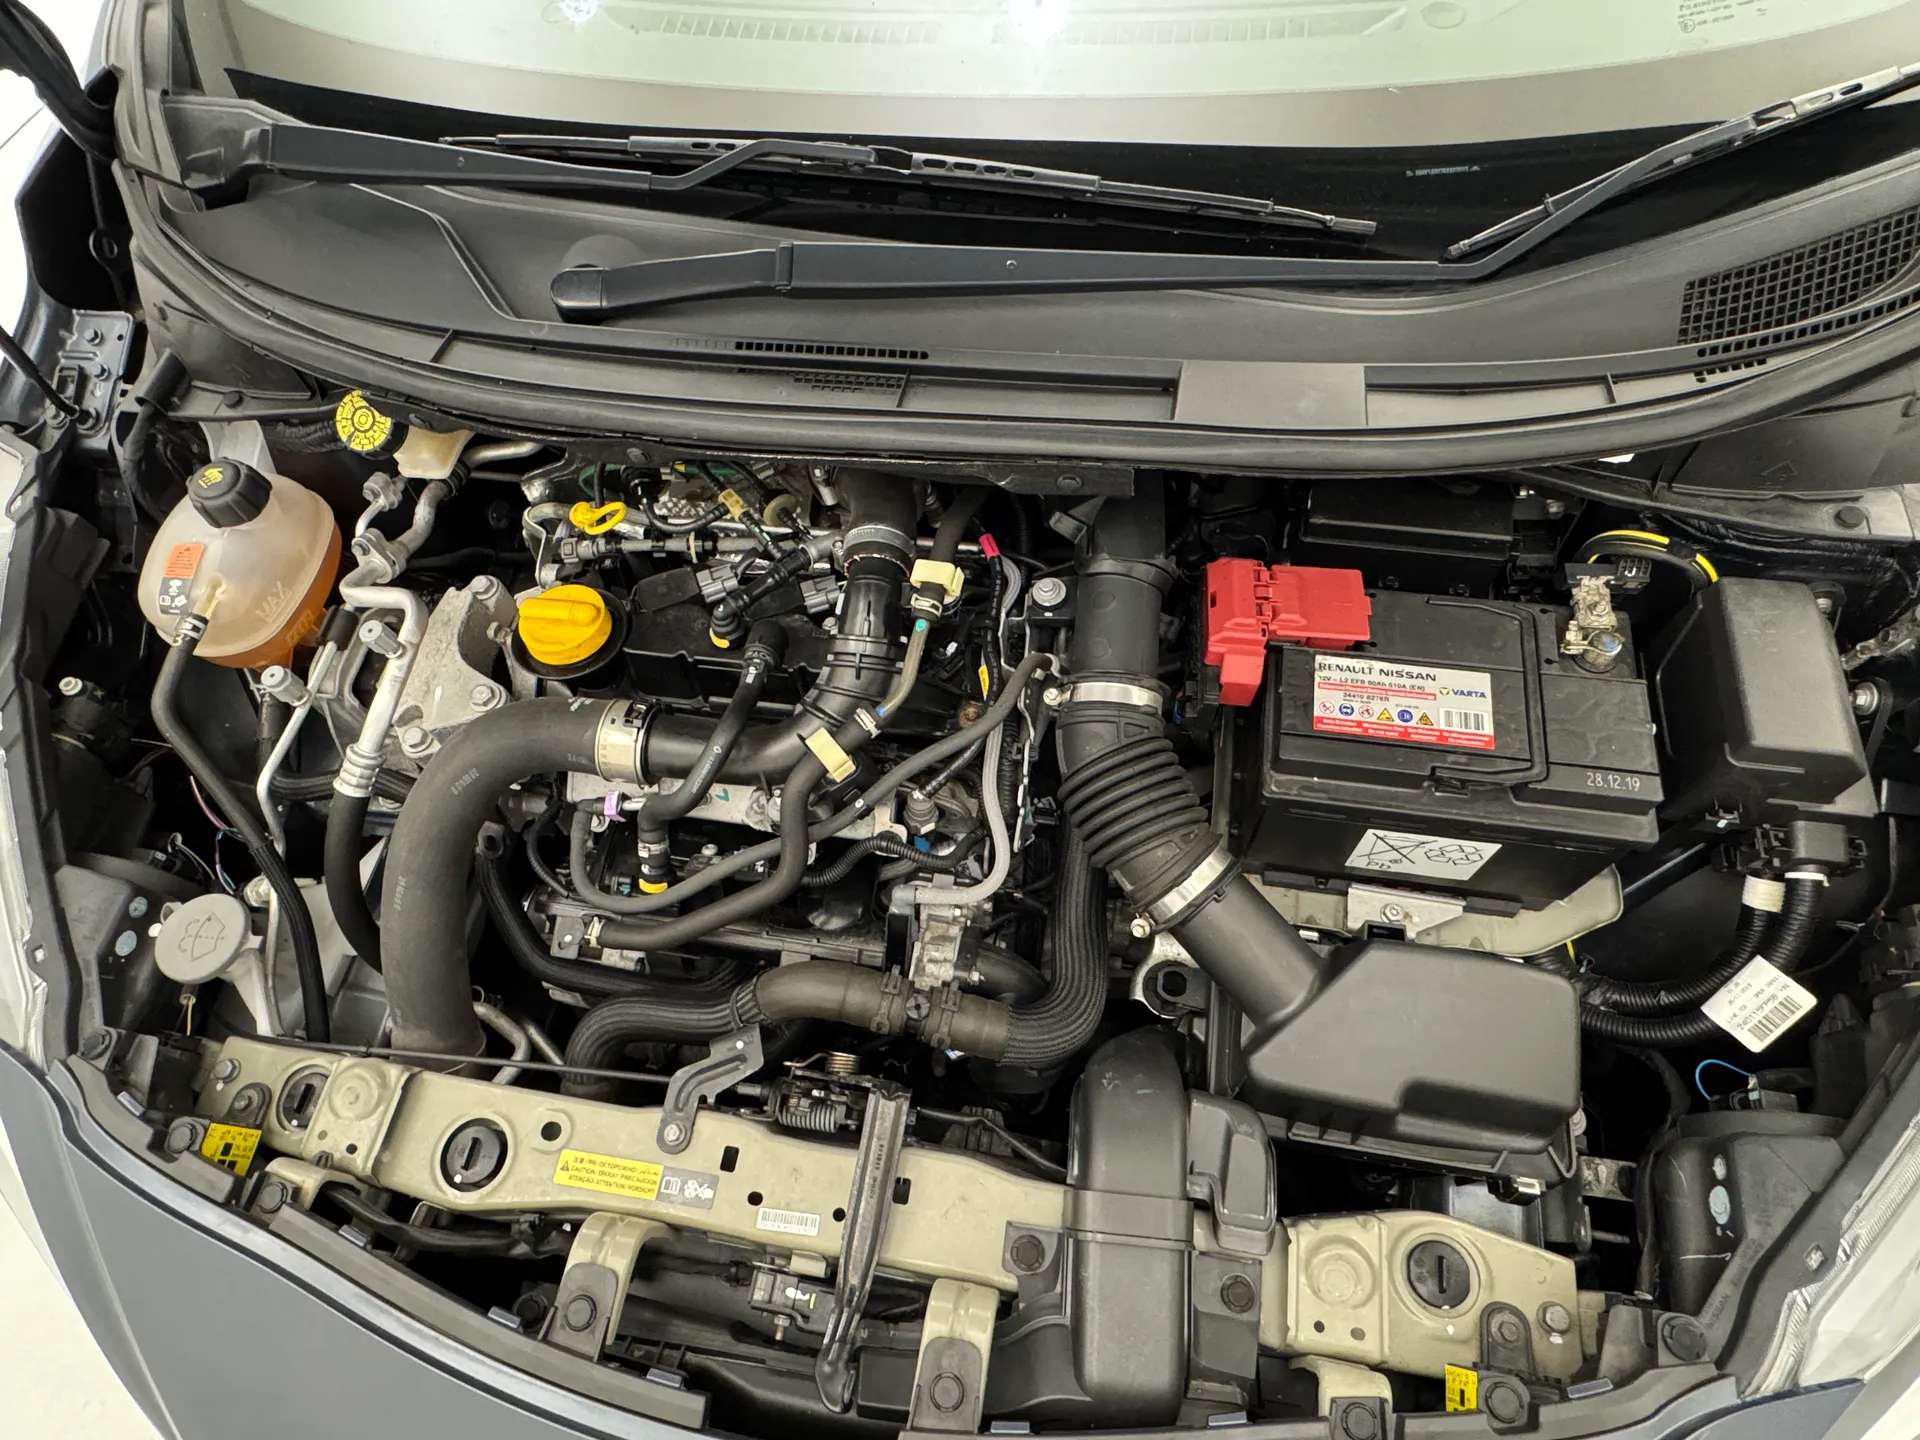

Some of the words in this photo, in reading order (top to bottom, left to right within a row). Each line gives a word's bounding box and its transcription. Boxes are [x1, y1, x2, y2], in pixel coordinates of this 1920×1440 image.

[1318, 662, 1374, 675] RENAULT
[1379, 668, 1437, 682] NISSAN
[1451, 688, 1487, 699] VARTA
[1586, 772, 1640, 792] 28.12.19
